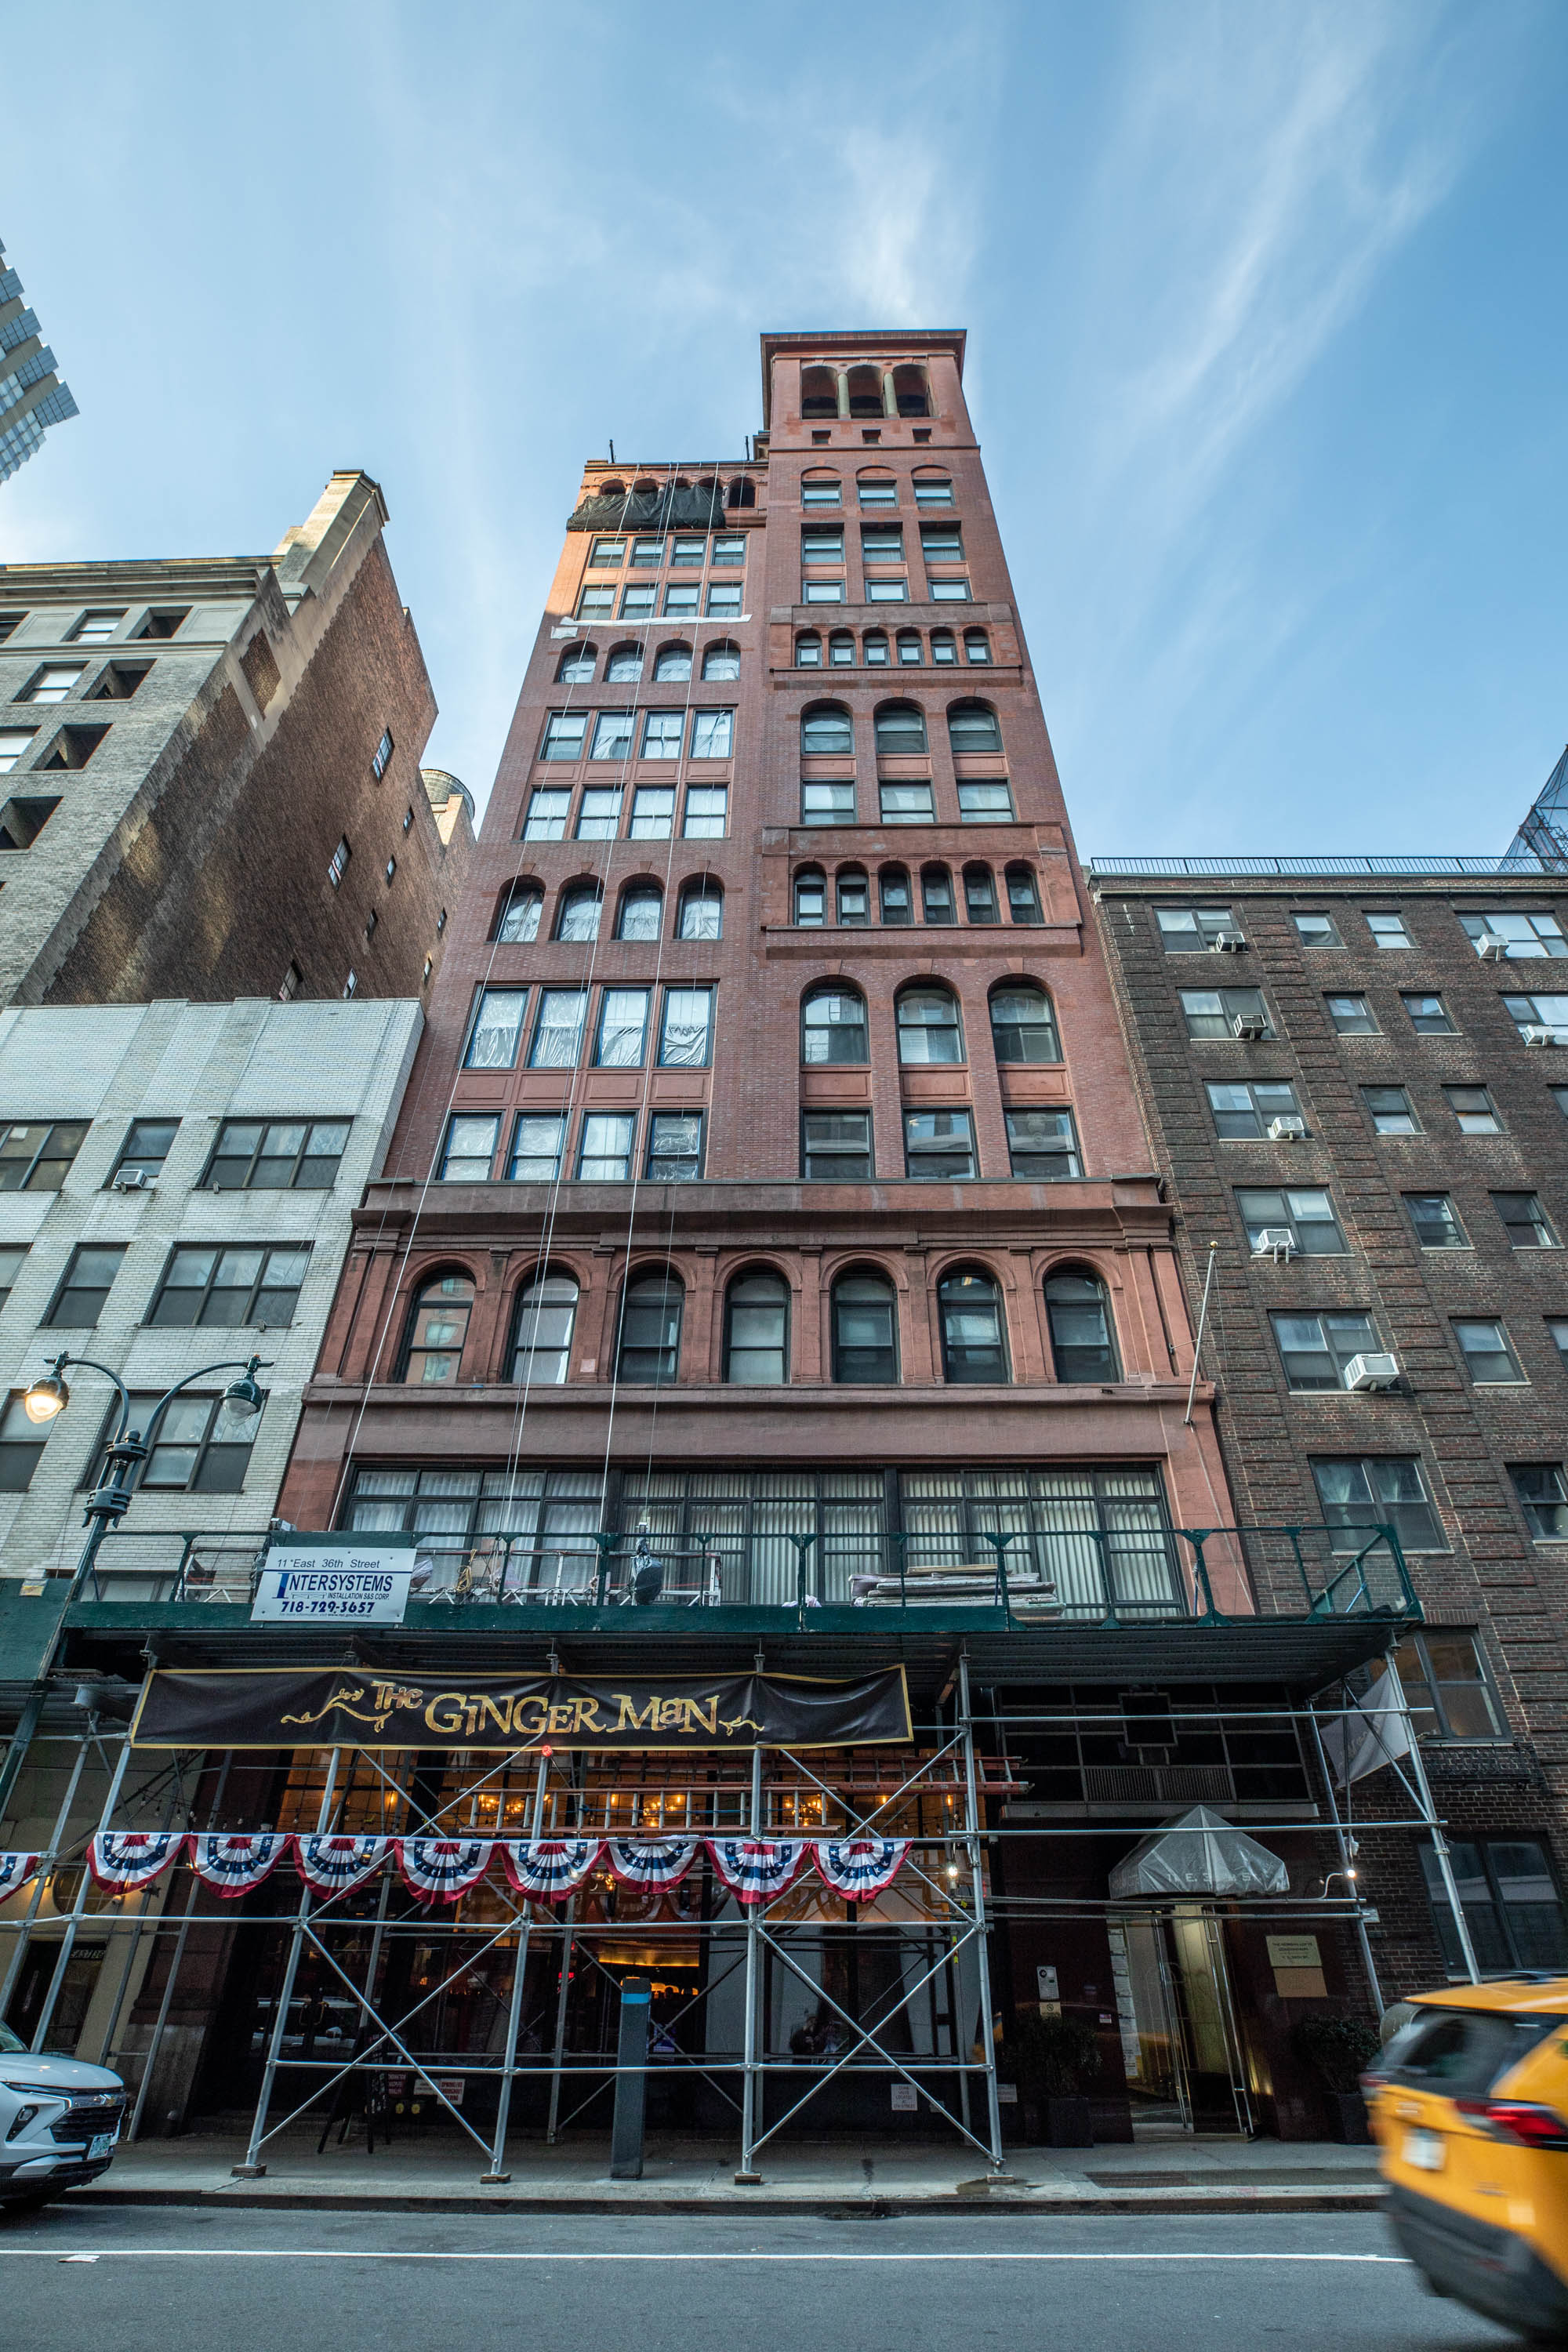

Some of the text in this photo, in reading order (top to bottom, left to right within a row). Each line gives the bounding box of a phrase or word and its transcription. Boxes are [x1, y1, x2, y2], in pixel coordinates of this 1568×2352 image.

[277, 1559, 380, 1569] 11 East 36th Street
[271, 1573, 393, 1599] INTERSYSTEMS
[281, 1601, 376, 1613] 718-729-3657
